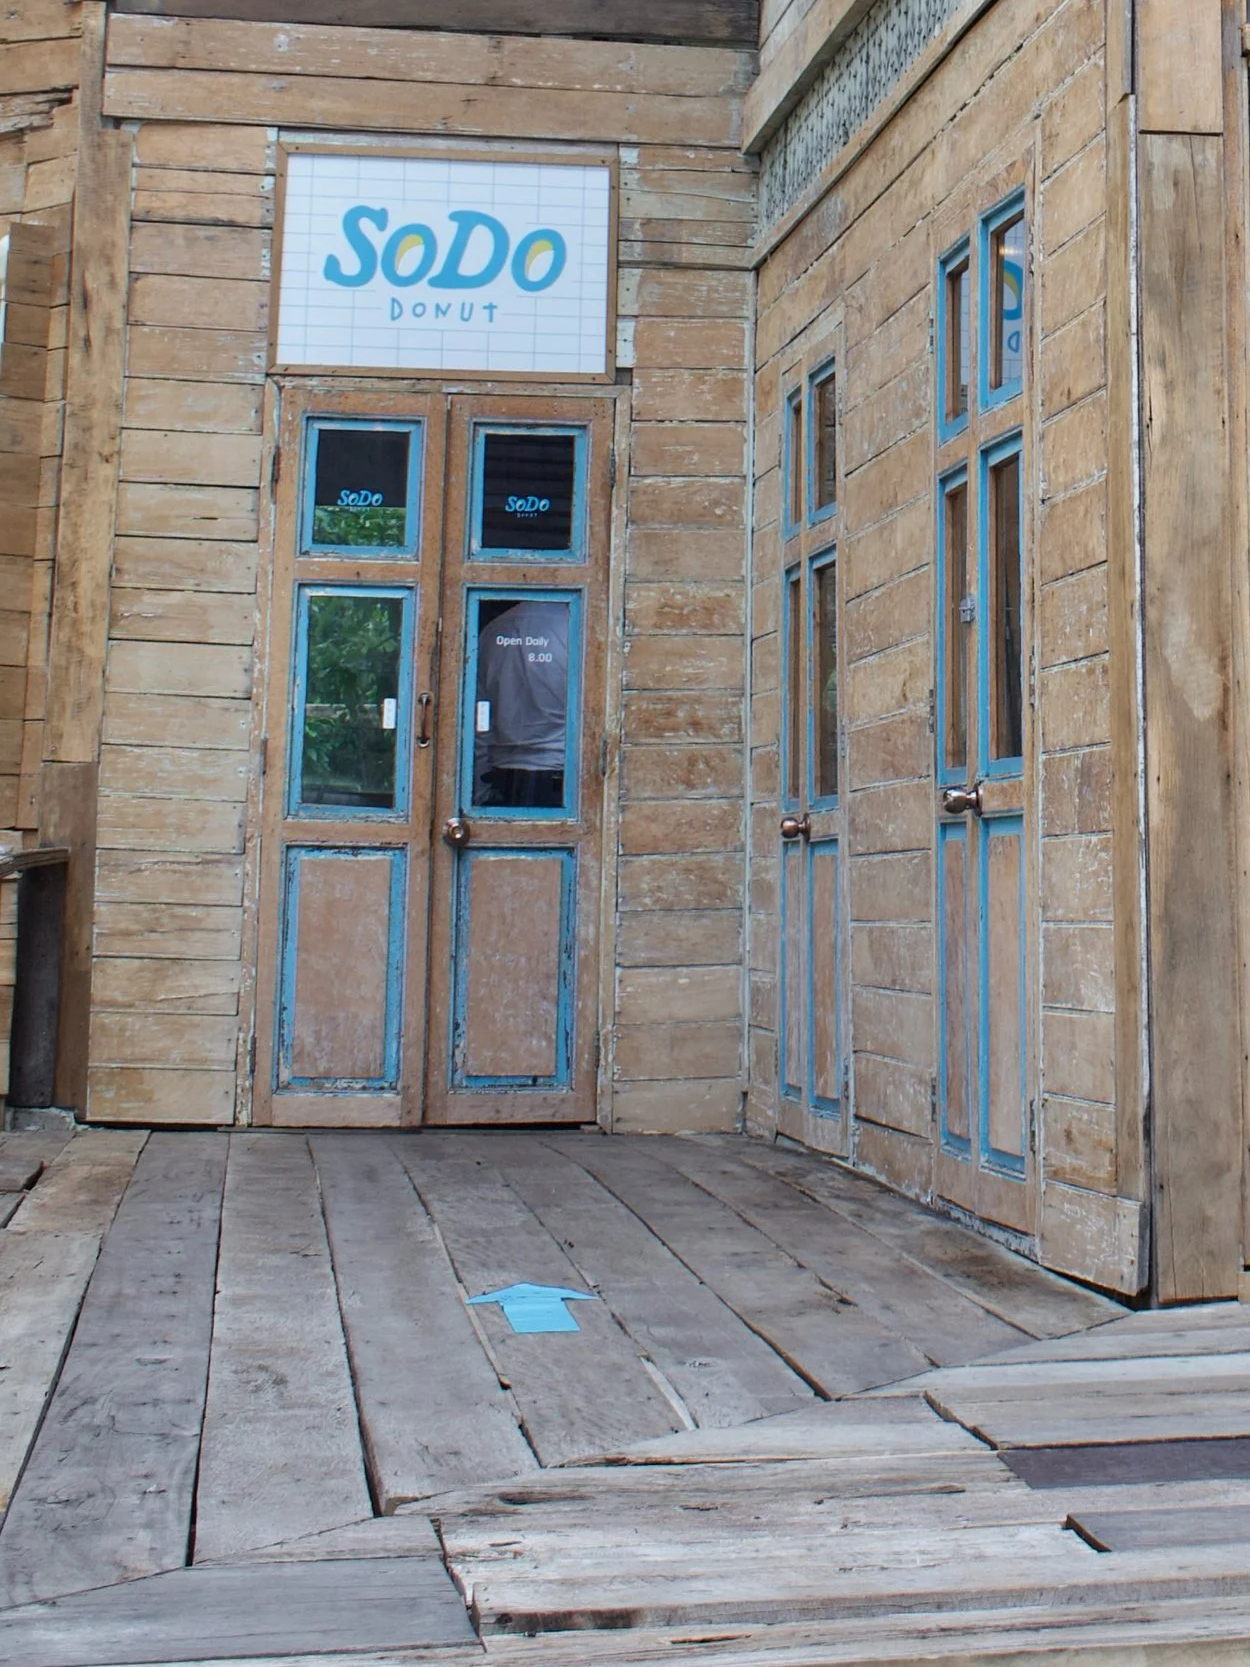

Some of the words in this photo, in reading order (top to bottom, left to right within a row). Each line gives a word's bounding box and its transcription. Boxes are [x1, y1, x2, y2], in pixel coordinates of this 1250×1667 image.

[496, 635, 523, 647] Open
[525, 636, 550, 648] Daily
[527, 652, 553, 663] 8.00
